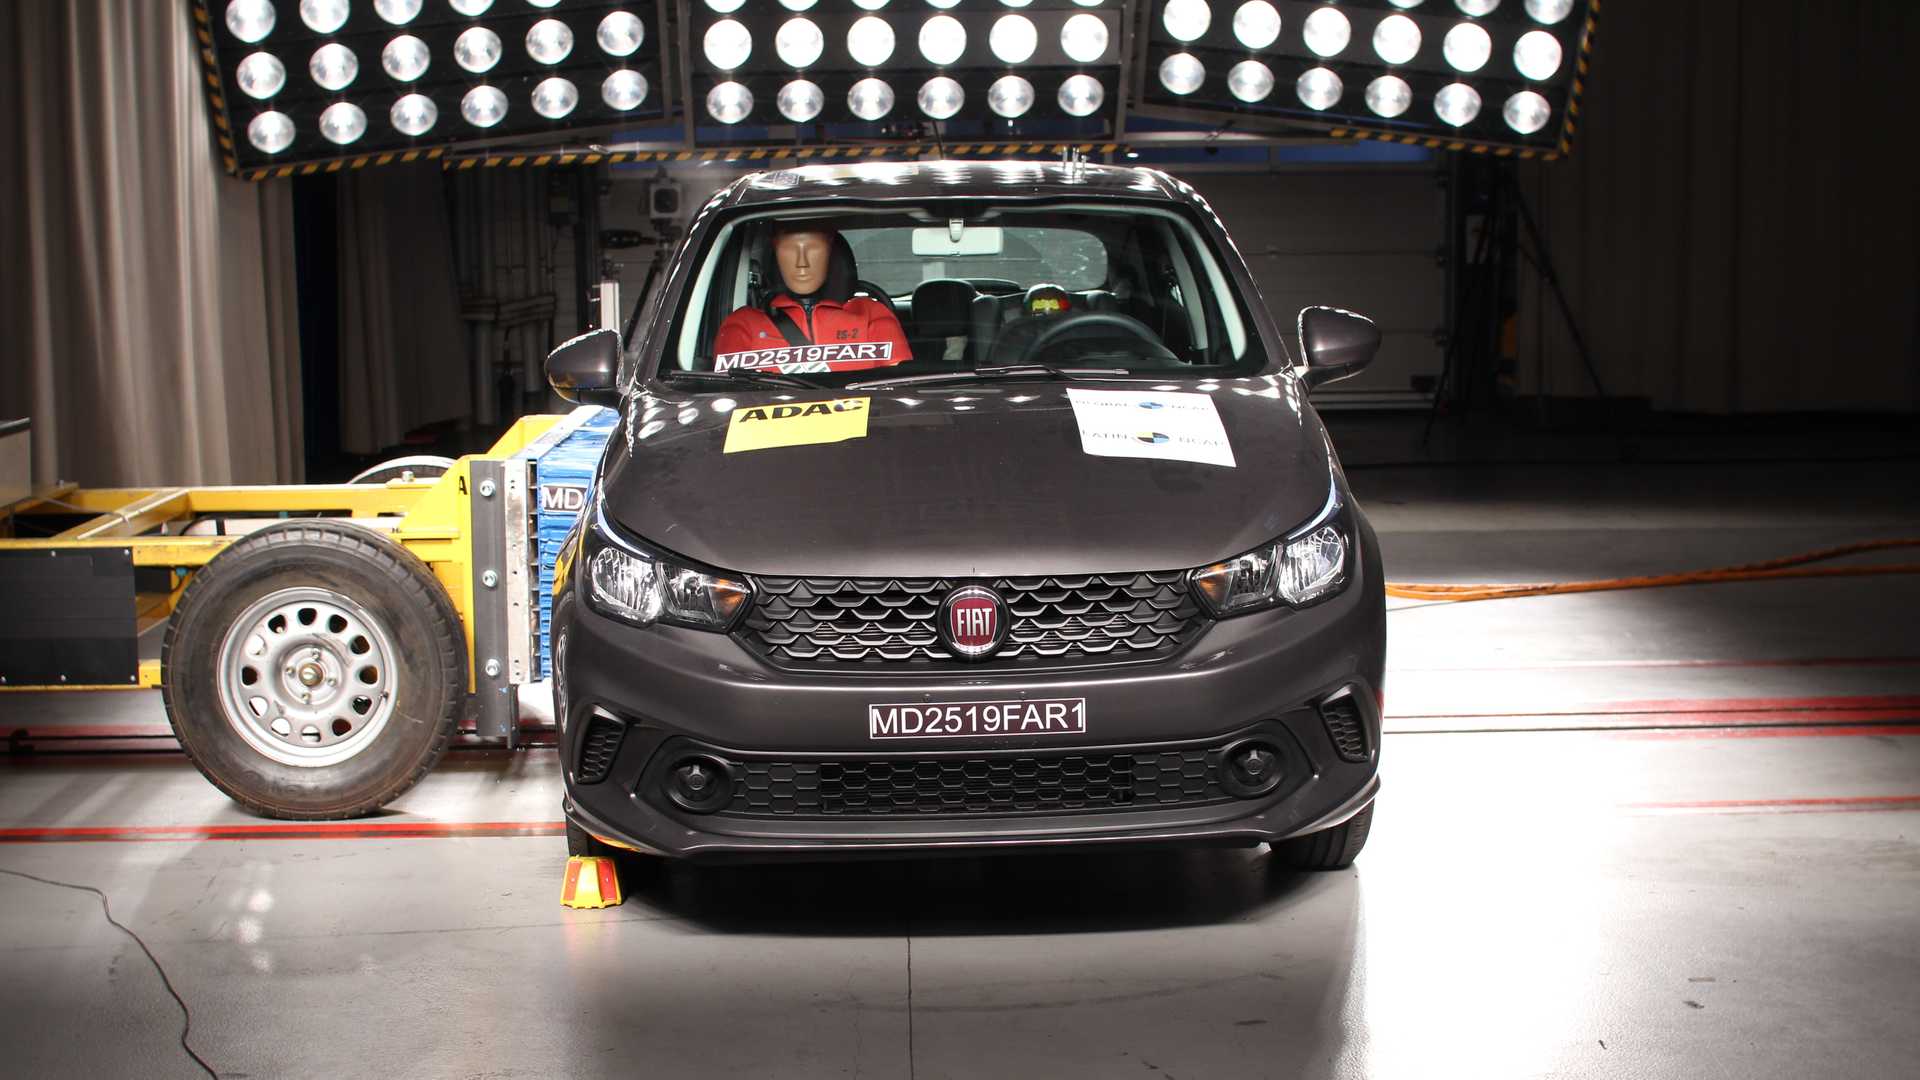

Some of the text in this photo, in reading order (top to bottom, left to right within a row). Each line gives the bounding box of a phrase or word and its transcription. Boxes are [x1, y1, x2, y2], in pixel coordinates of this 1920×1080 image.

[716, 344, 891, 371] MD2519FAR1
[739, 400, 864, 423] ADAC
[957, 608, 992, 637] FIAT
[872, 702, 1084, 735] MD2519FAR1
